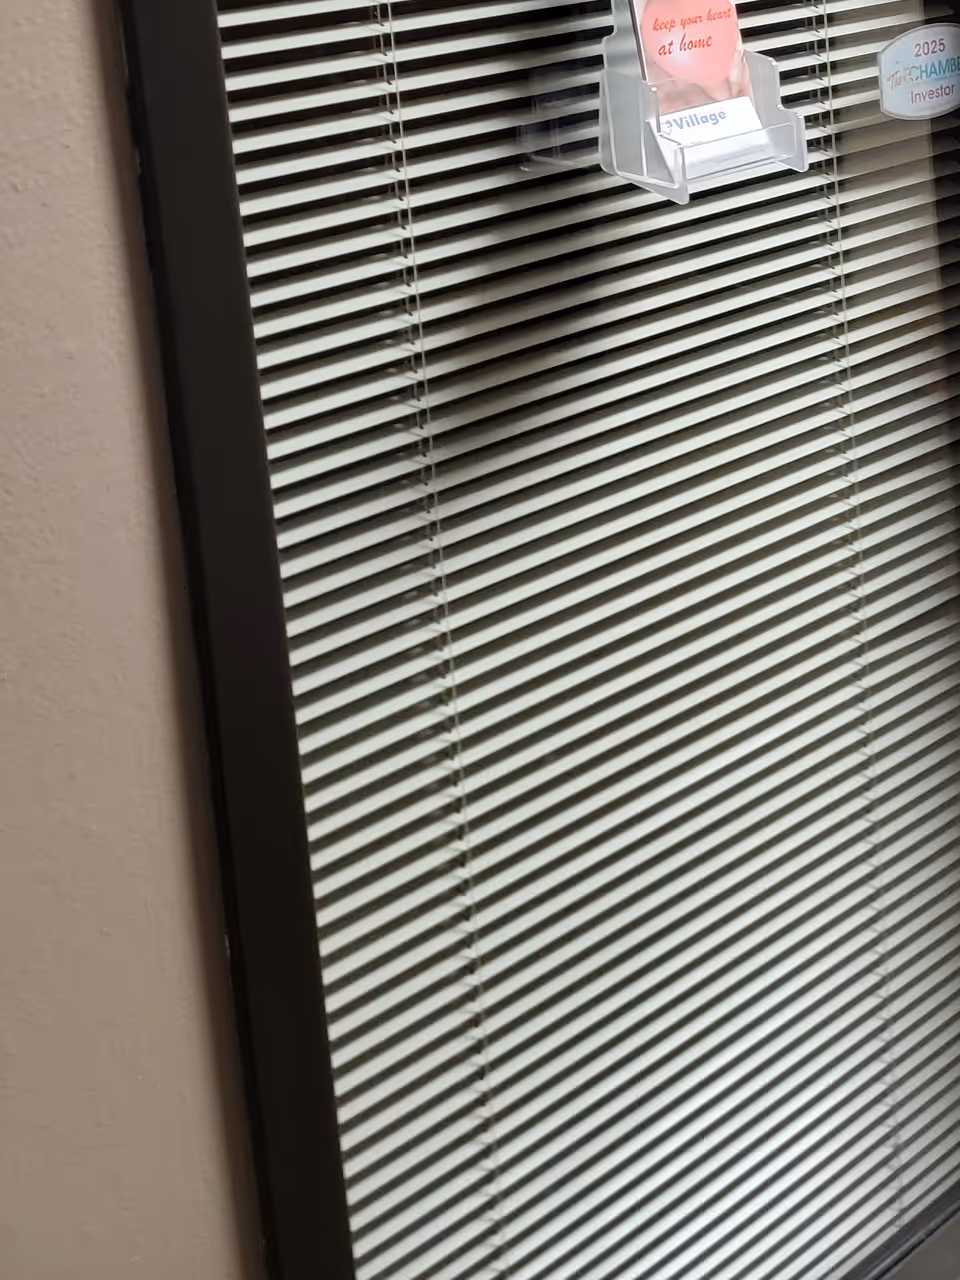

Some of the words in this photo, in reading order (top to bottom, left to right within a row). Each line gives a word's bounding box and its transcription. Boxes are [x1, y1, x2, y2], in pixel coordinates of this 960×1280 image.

[652, 17, 676, 33] keep
[680, 15, 703, 31] your
[706, 7, 732, 21] heart
[657, 39, 674, 56] at
[679, 32, 713, 52] home
[914, 38, 946, 57] 2025
[910, 84, 955, 105] Investor
[672, 110, 727, 130] Village
